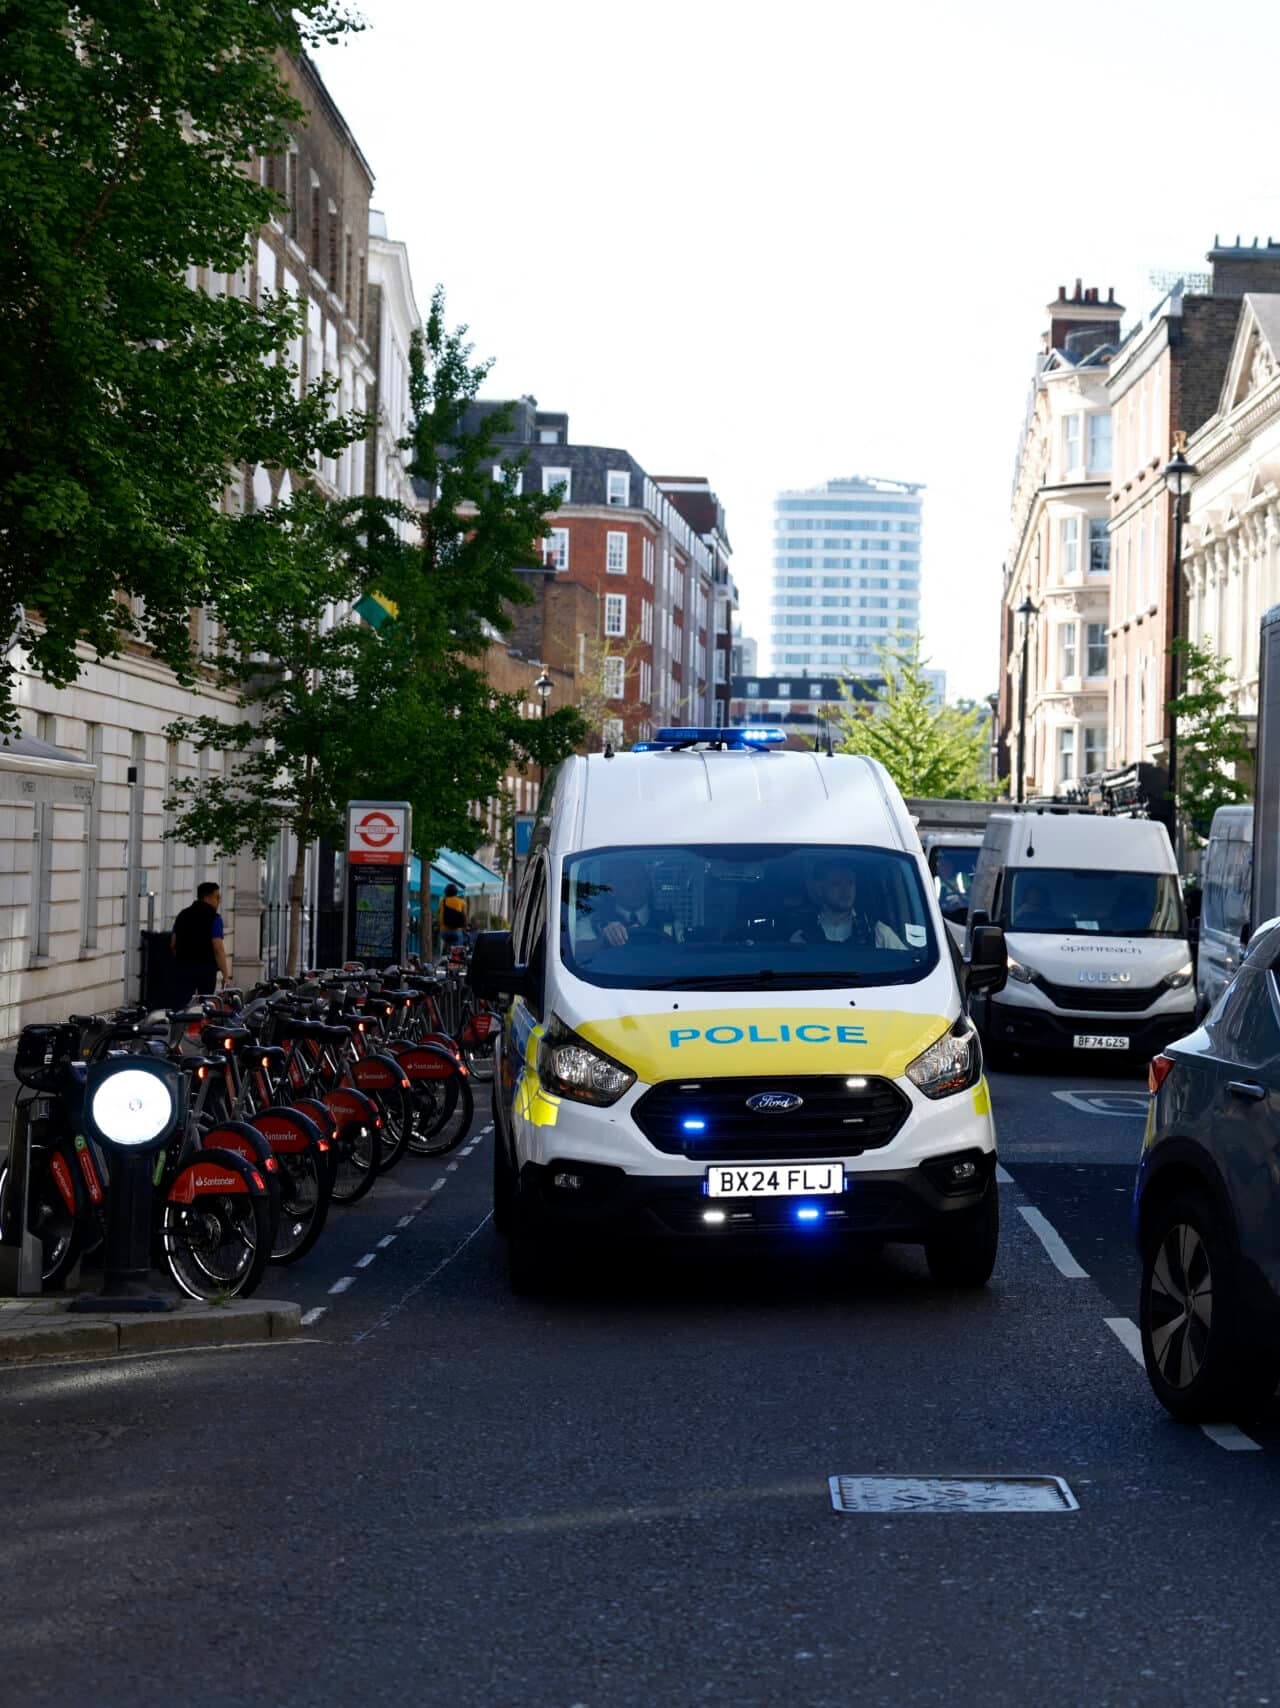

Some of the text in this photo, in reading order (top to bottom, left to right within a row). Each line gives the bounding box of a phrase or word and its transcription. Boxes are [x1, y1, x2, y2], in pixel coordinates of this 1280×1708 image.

[1060, 944, 1142, 955] openreach
[1078, 969, 1131, 982] IVECO
[669, 1024, 868, 1048] POLICE
[758, 1094, 793, 1109] Ford
[264, 1130, 298, 1141] Santander
[203, 1176, 236, 1186] Santander
[720, 1169, 832, 1193] BX24 FLJ
